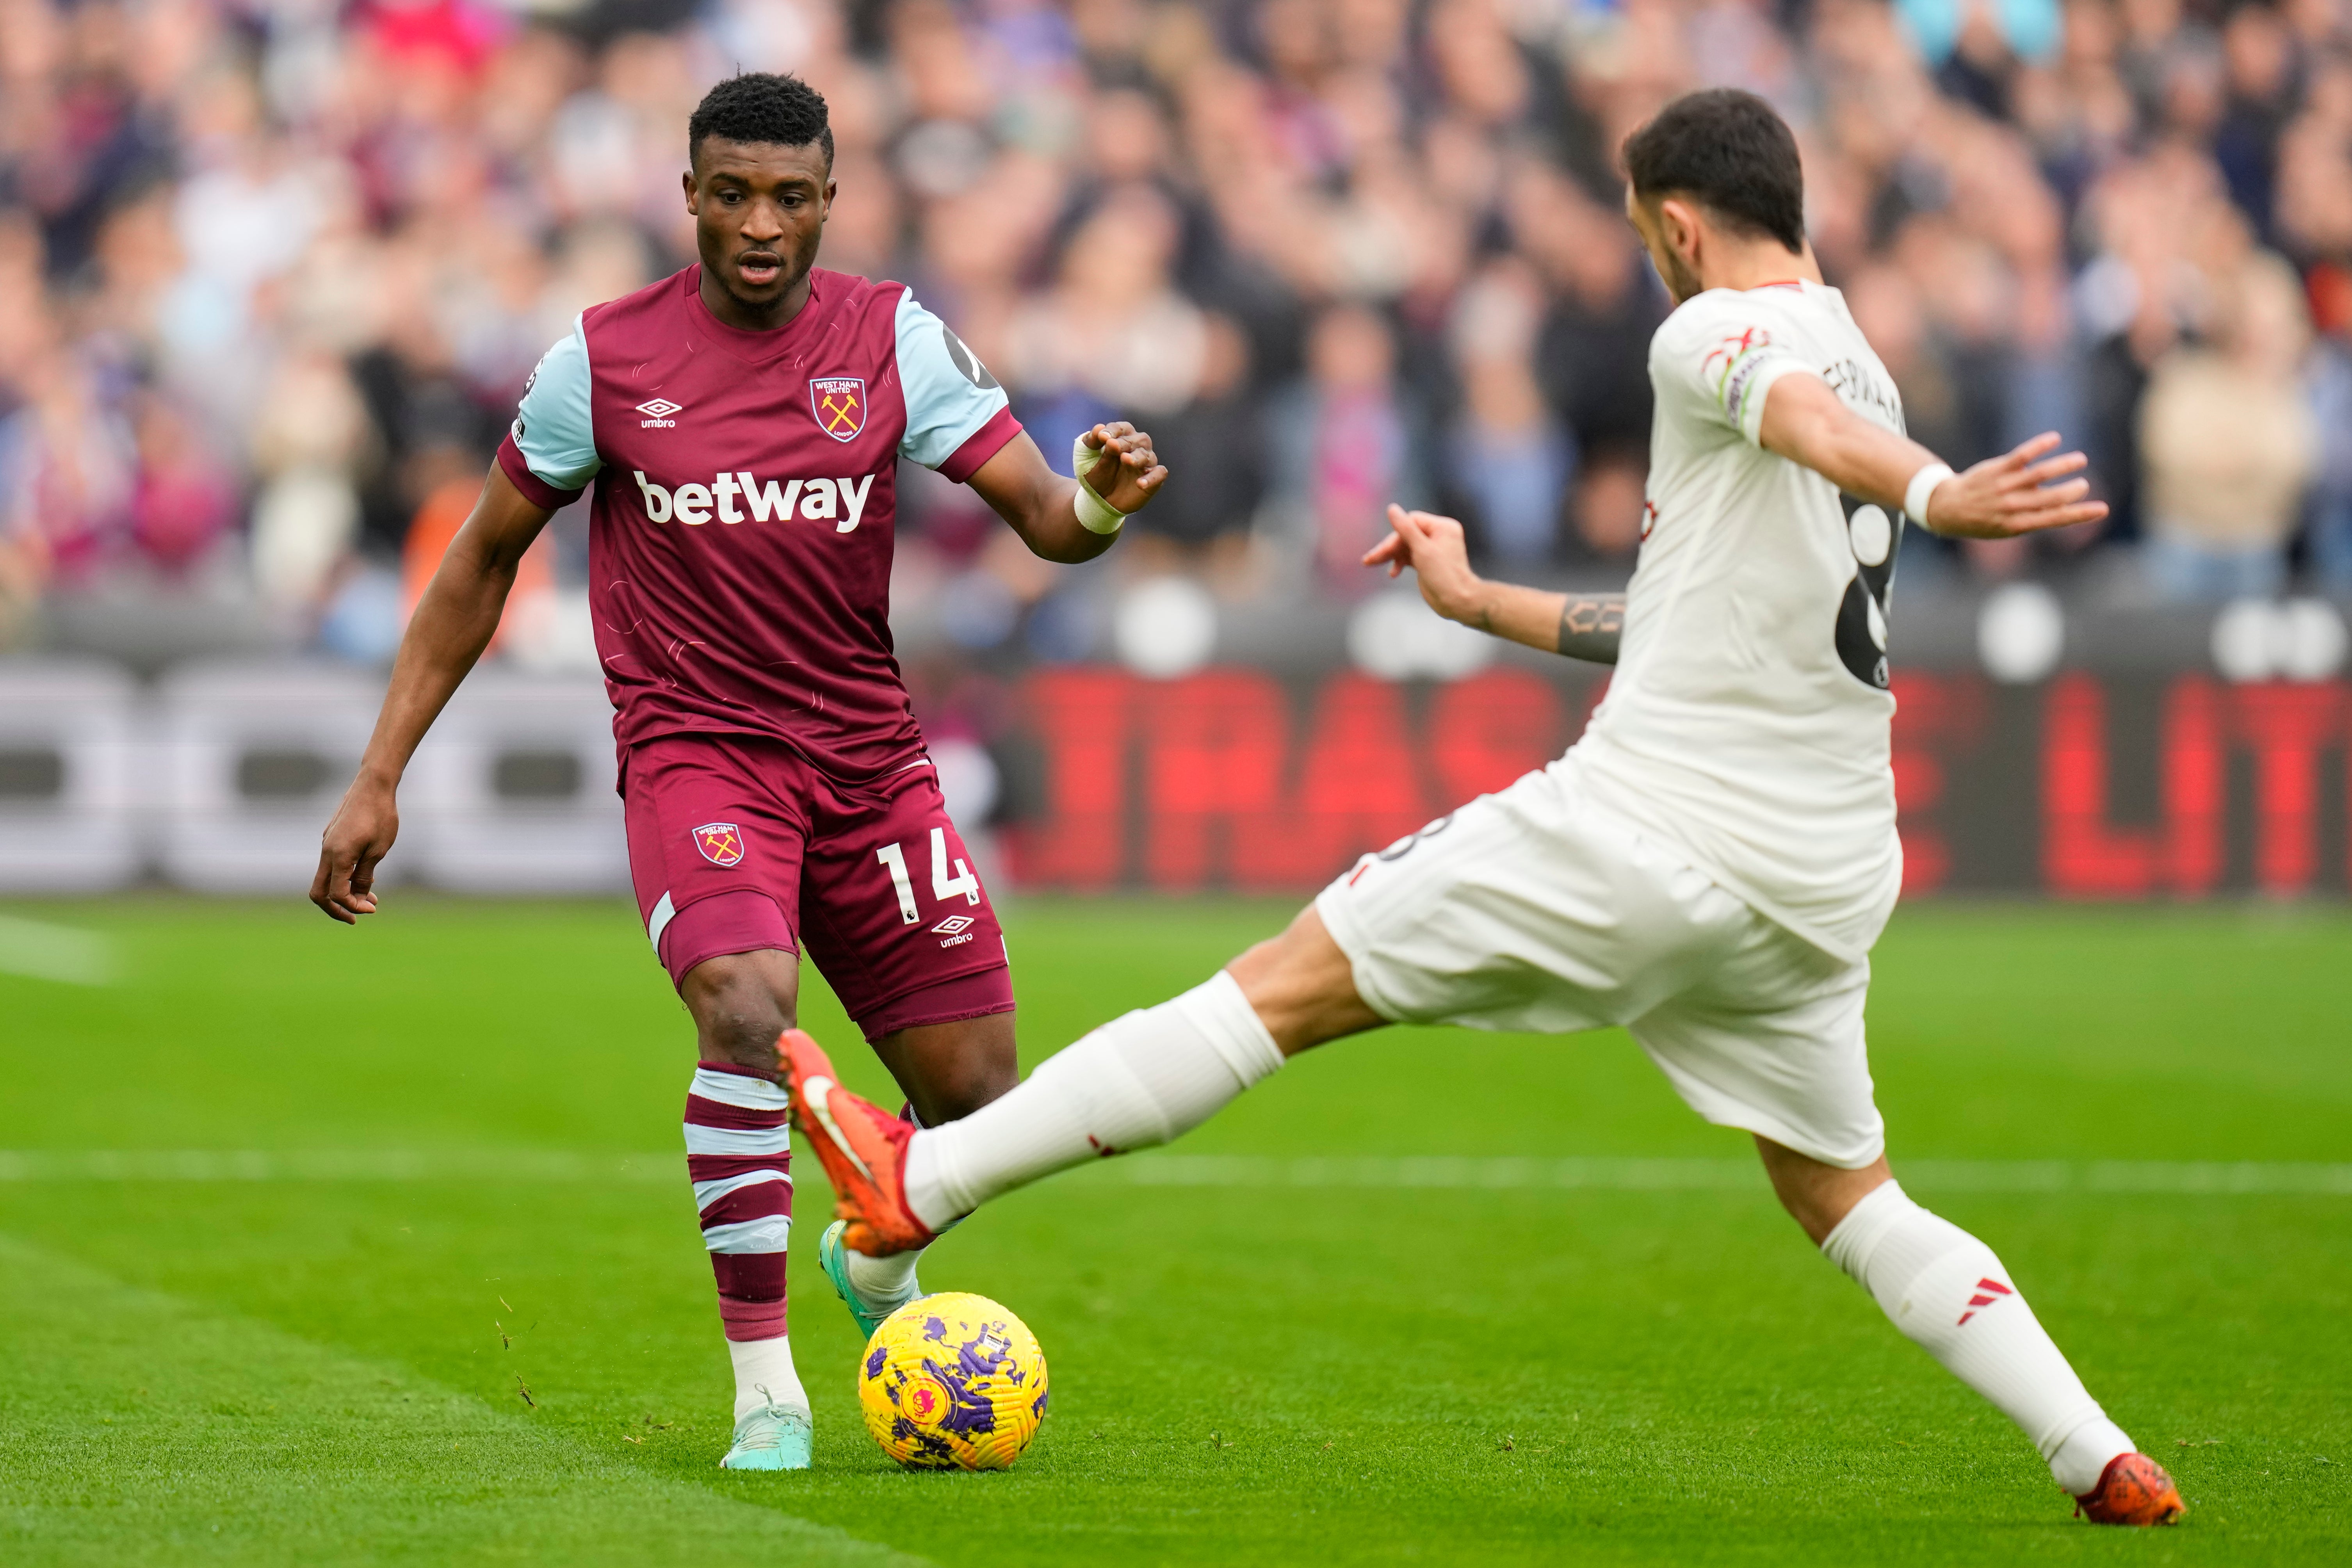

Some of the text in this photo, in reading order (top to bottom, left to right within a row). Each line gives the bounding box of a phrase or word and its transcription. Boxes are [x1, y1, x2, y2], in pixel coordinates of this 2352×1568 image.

[815, 381, 838, 390] WEST
[641, 418, 675, 428] umbro
[634, 470, 875, 533] betway
[698, 826, 717, 835] WEST
[876, 827, 980, 925] 14
[940, 933, 973, 948] umbro
